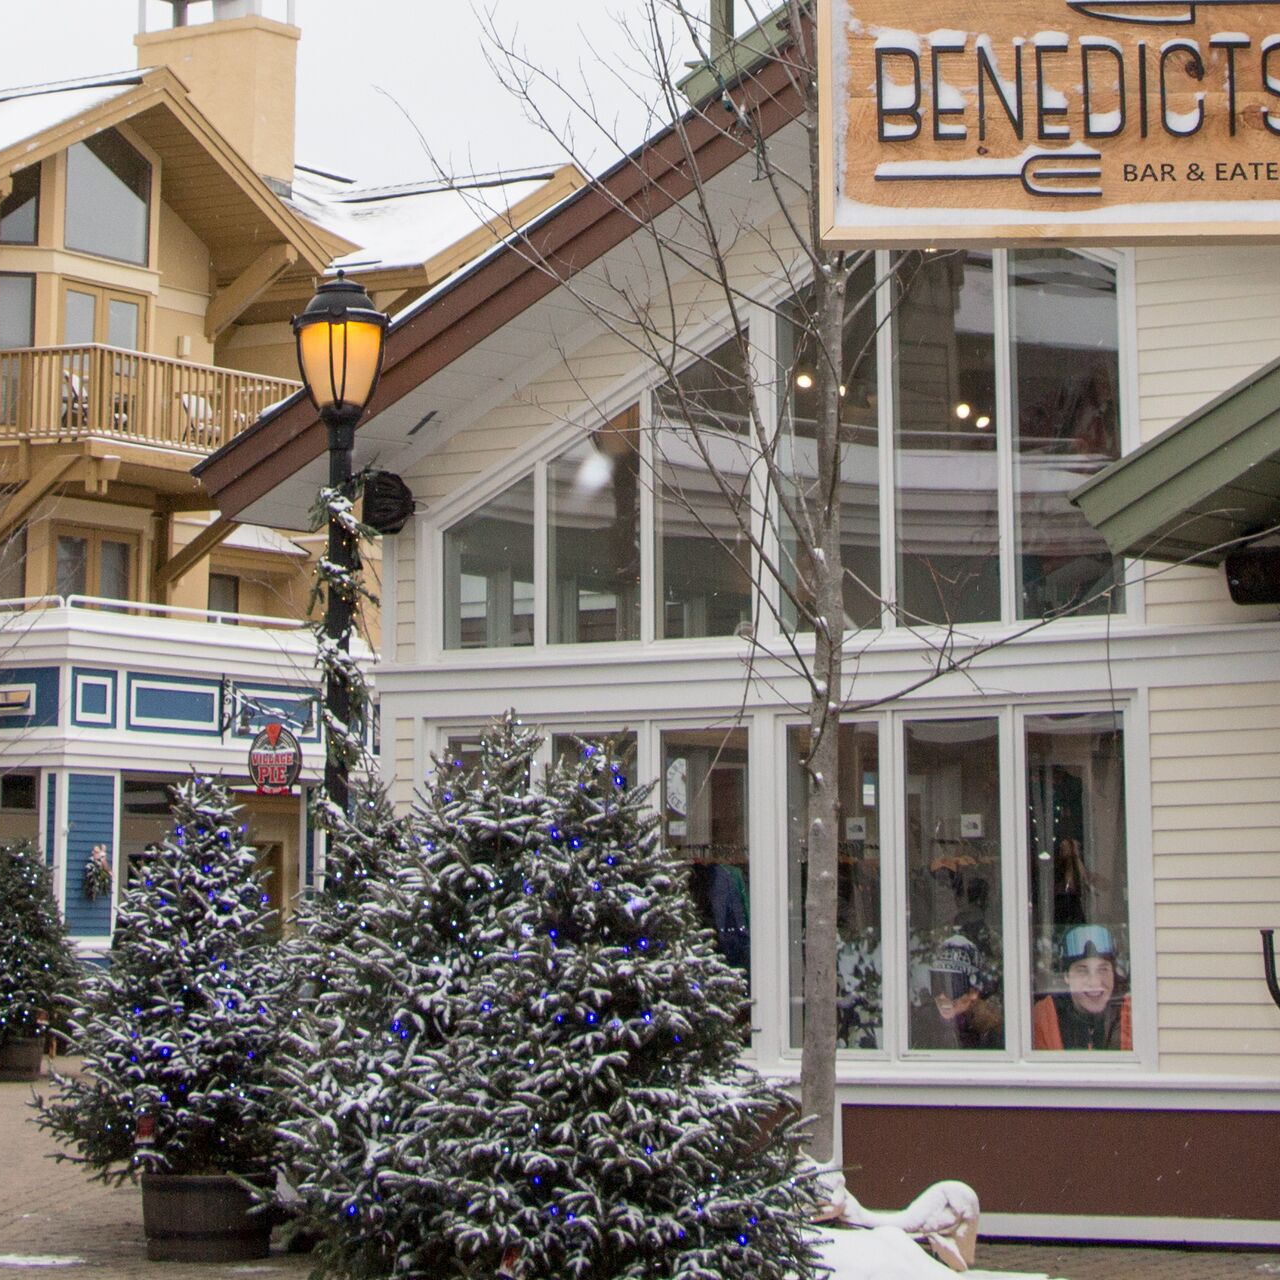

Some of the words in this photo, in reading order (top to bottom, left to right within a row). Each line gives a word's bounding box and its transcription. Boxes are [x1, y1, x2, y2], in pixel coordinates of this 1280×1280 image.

[1123, 162, 1177, 182] BAR
[1186, 162, 1206, 182] &
[251, 752, 294, 766] VILLAGE
[258, 766, 288, 784] PIE
